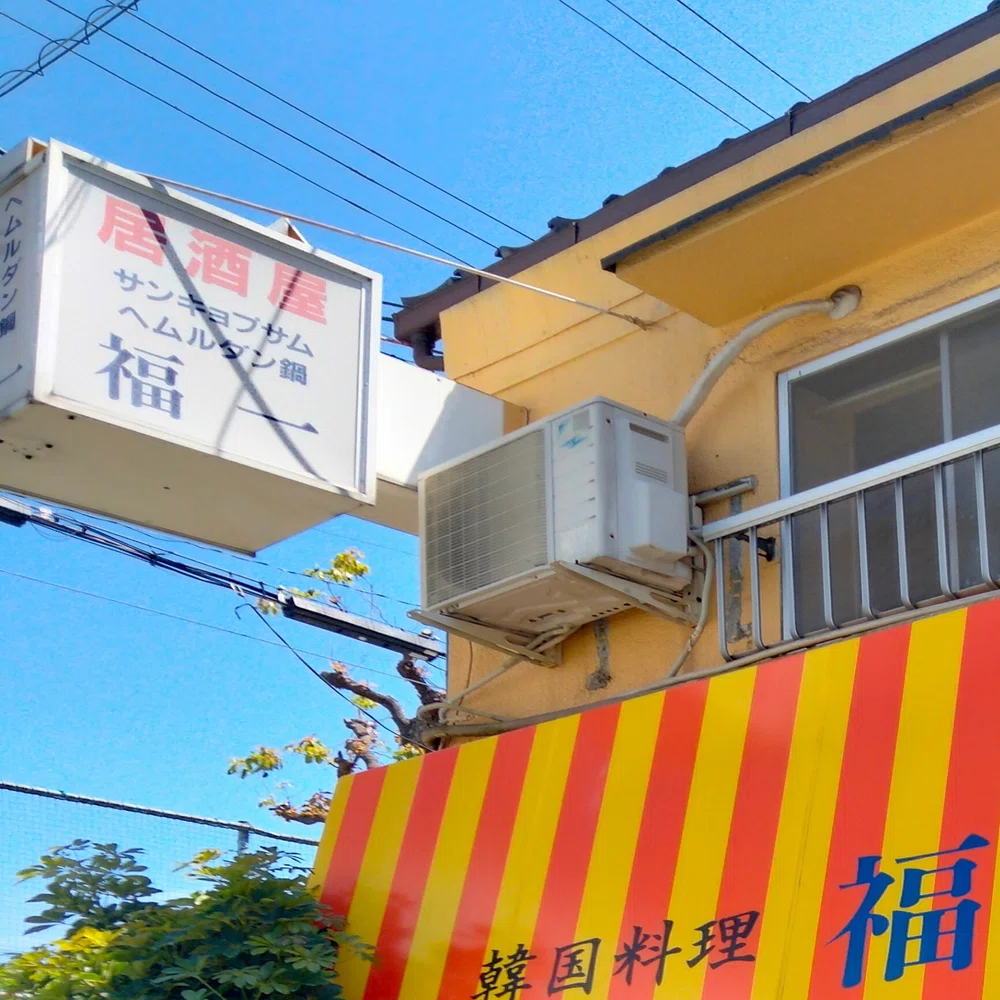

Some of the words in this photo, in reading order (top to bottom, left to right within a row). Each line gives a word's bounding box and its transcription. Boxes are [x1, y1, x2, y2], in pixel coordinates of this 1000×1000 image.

[97, 195, 327, 325] 居酒屋
[95, 332, 319, 420] 福一
[118, 306, 307, 386] ヘムルダン鍋
